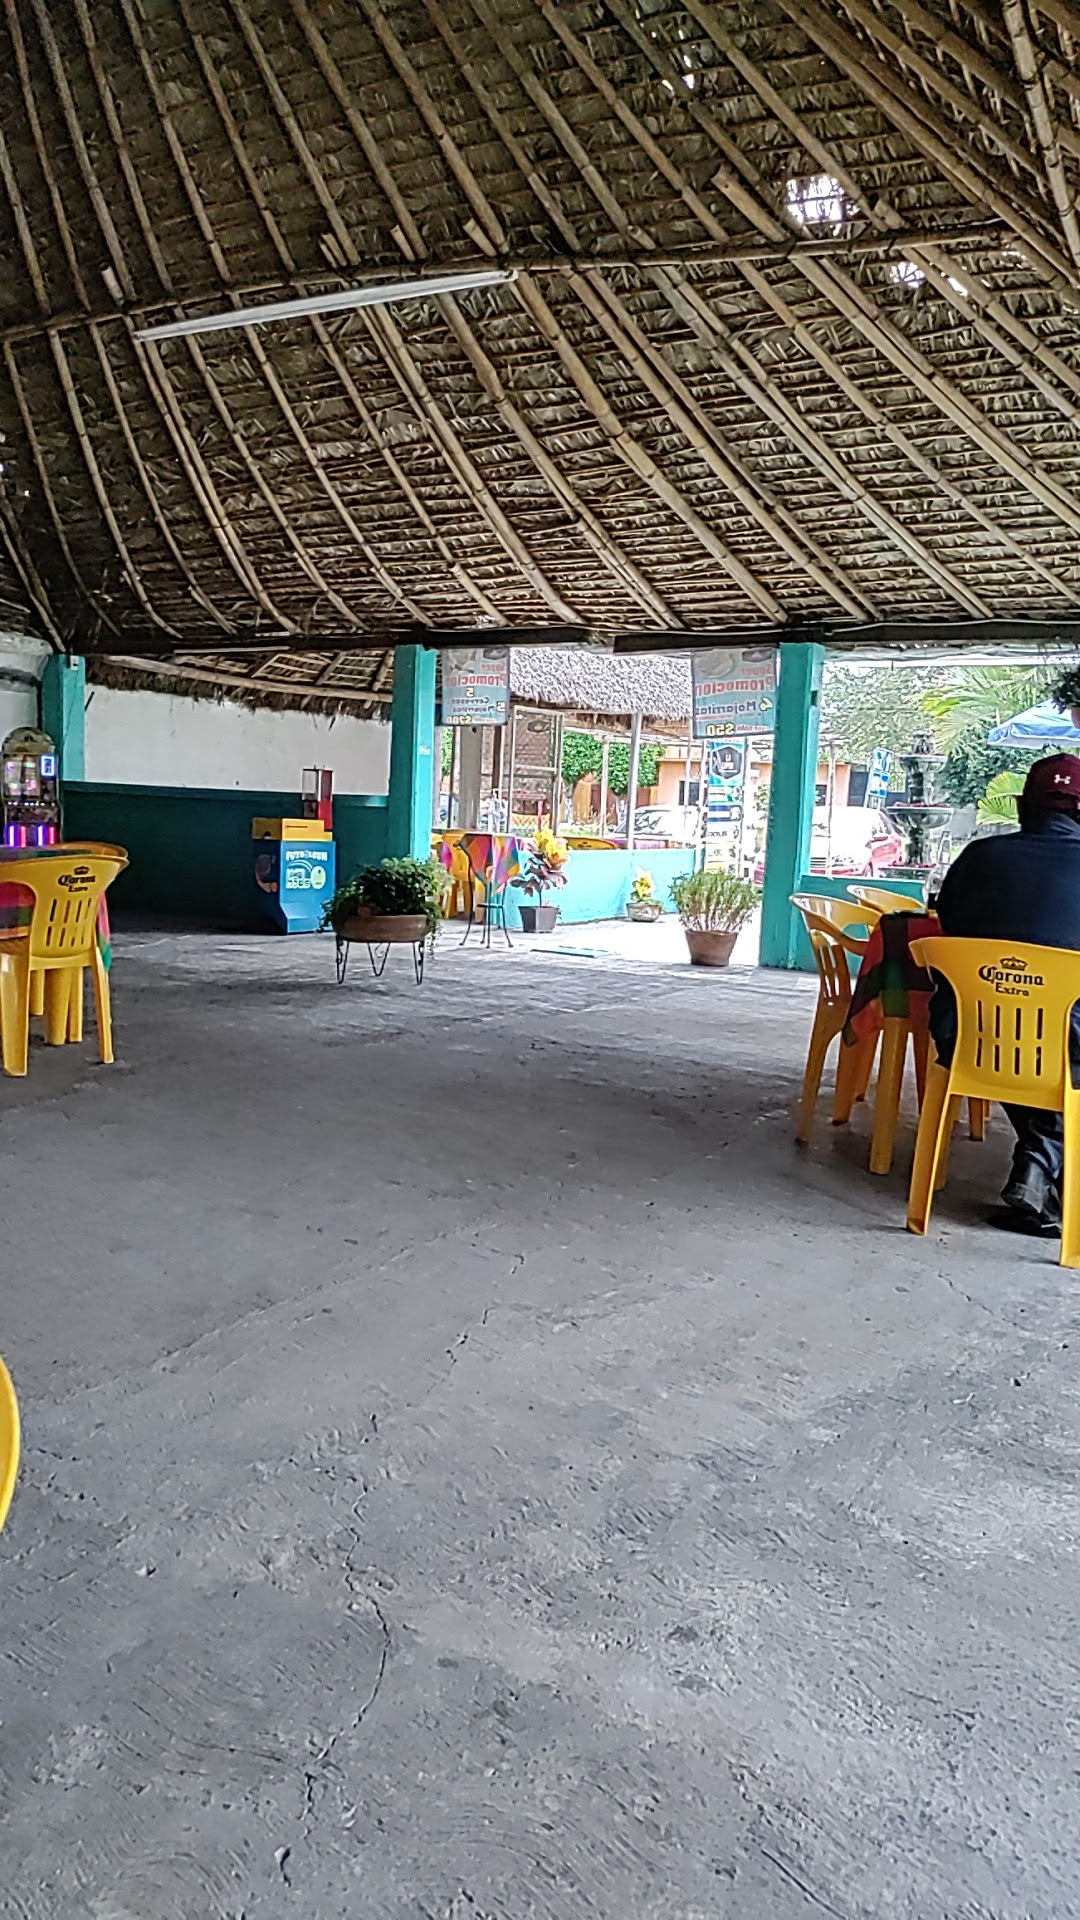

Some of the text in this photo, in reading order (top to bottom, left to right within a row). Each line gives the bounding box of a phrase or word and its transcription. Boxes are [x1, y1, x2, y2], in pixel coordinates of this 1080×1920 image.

[58, 874, 96, 887] Corona
[978, 965, 1044, 985] Corona
[995, 981, 1029, 996] Extra
